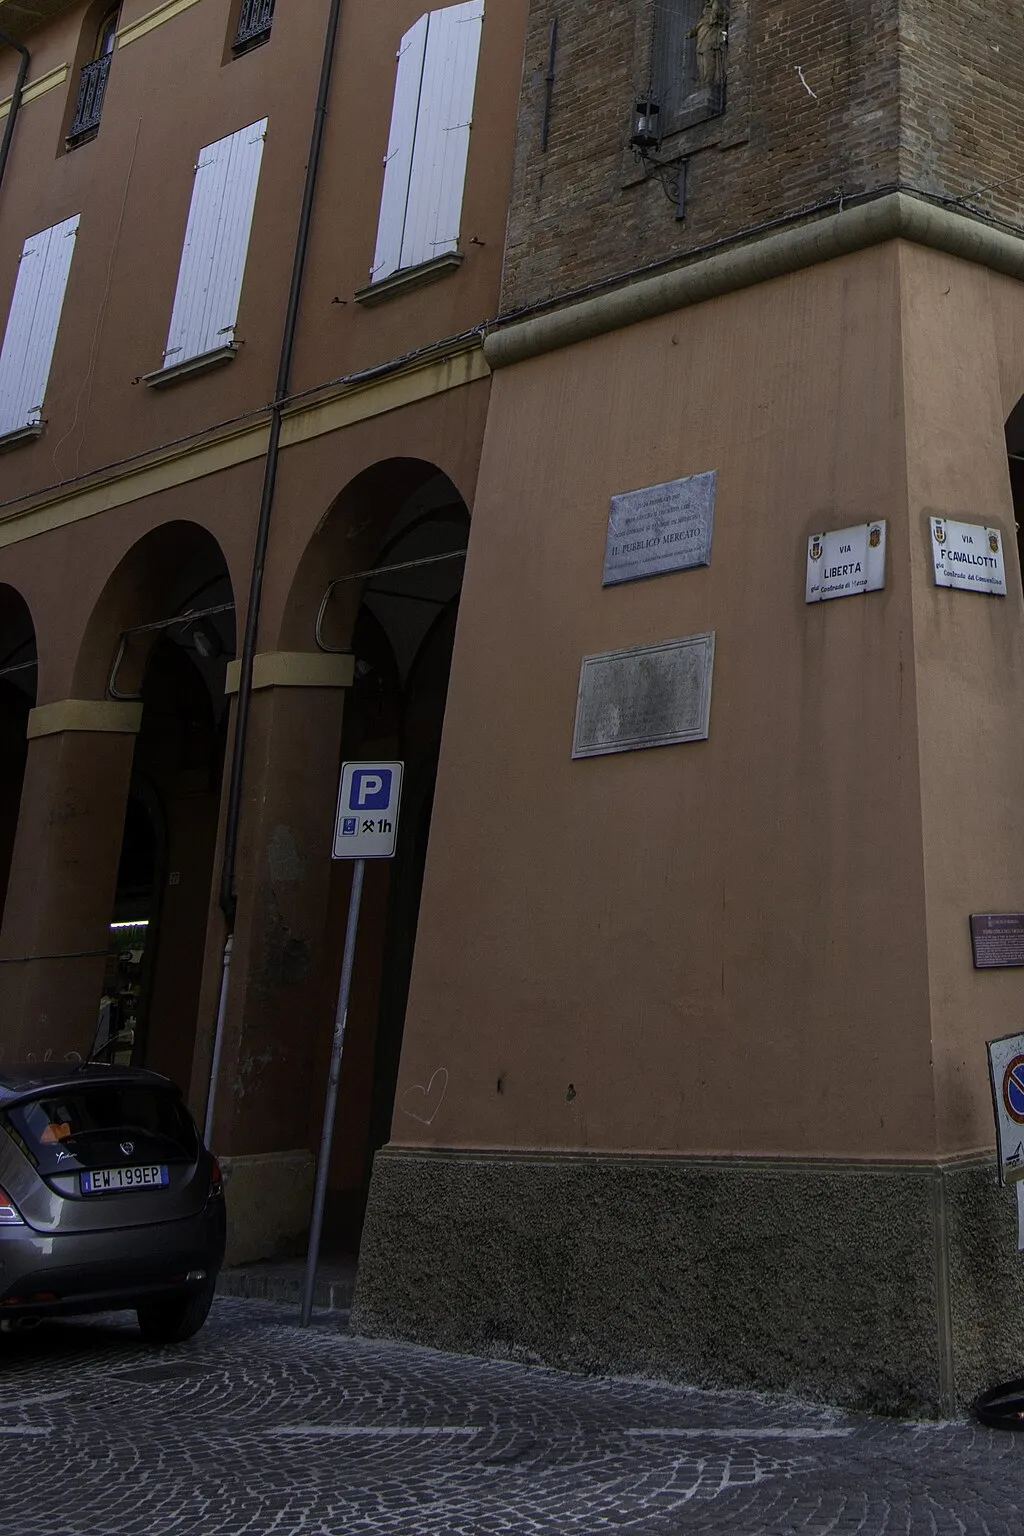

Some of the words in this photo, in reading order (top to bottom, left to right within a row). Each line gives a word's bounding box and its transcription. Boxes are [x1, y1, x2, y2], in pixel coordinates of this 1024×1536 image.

[612, 547, 619, 556] IL
[622, 537, 660, 554] PUBBLICO
[662, 527, 701, 545] MERCATO
[962, 535, 974, 545] VIA
[839, 544, 852, 554] VIA
[820, 584, 844, 593] Contrada
[357, 774, 383, 805] P
[377, 818, 392, 833] 1h
[92, 1171, 111, 1189] EW
[117, 1166, 160, 1186] 199EP
